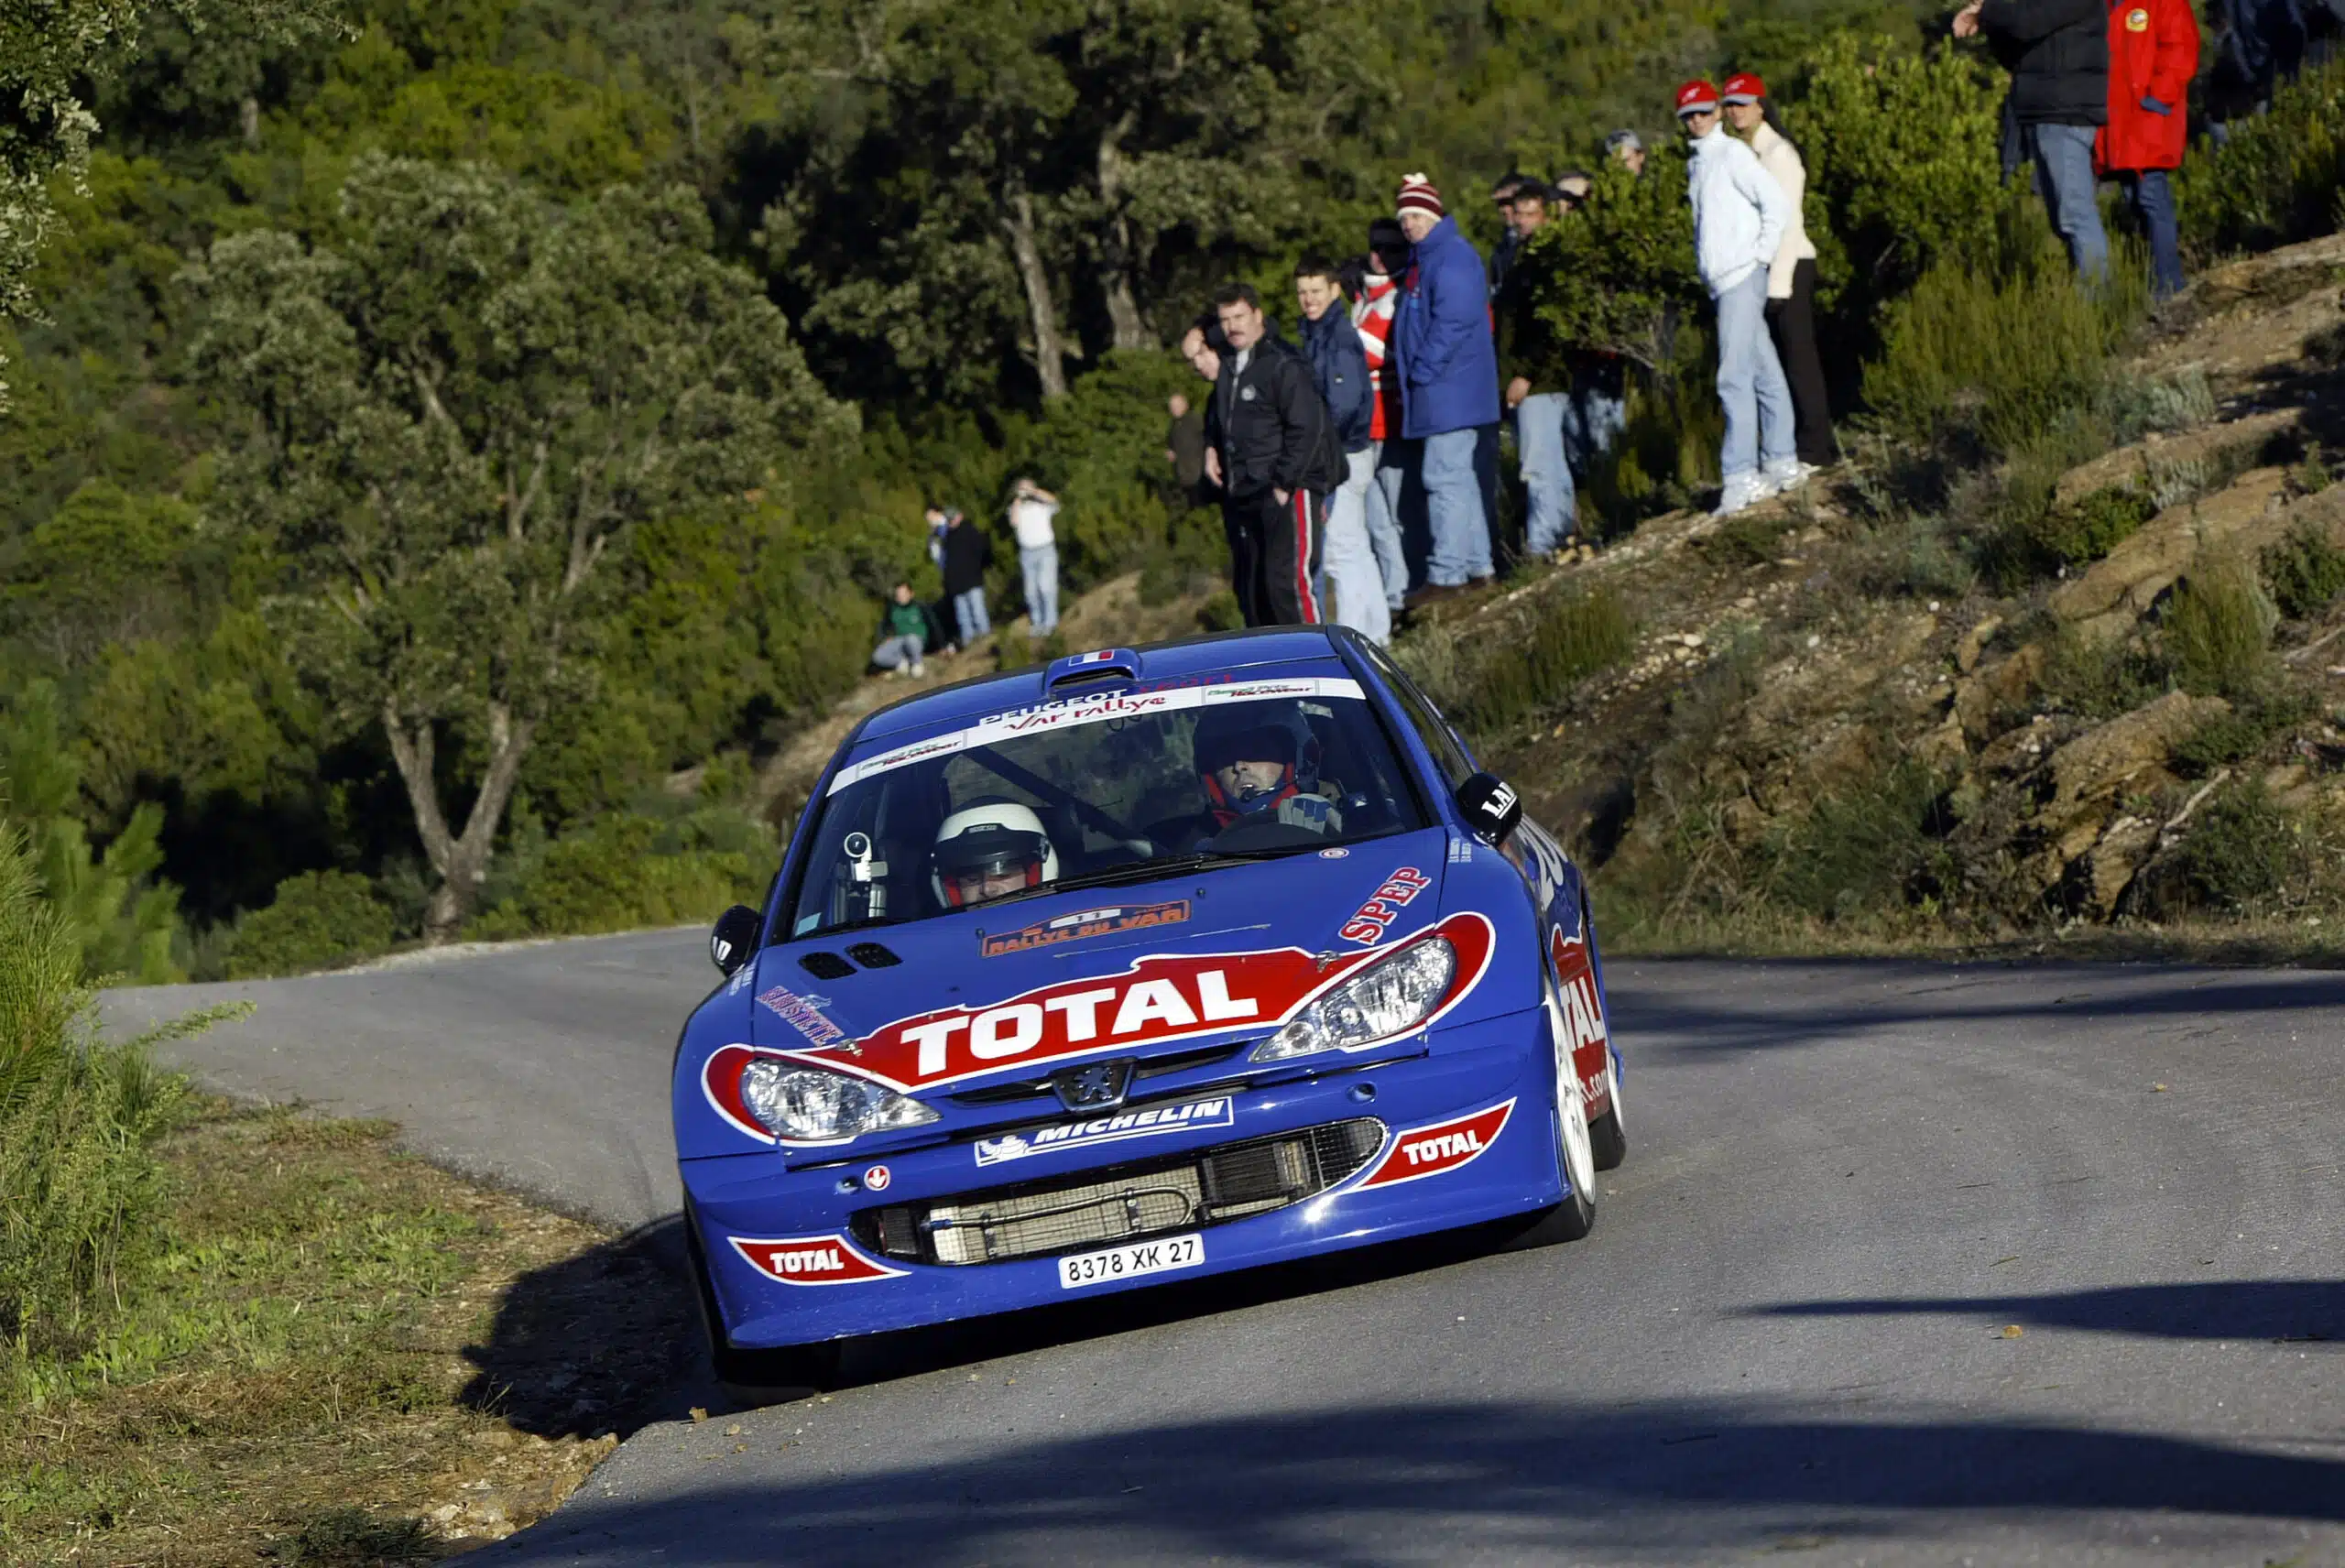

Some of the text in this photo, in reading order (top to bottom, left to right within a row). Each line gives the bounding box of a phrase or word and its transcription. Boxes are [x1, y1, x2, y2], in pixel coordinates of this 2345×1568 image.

[979, 689, 1127, 726] PEUGEOT
[1120, 908, 1183, 930] VAR
[1338, 866, 1432, 945] SPEP
[900, 970, 1259, 1077] TOTAL
[1559, 976, 1605, 1052] TAL
[1034, 1100, 1224, 1144] MICHELIN
[1402, 1129, 1483, 1166] TOTAL
[769, 1248, 845, 1274] TOTAL
[1069, 1240, 1194, 1281] 8378 XK 27
